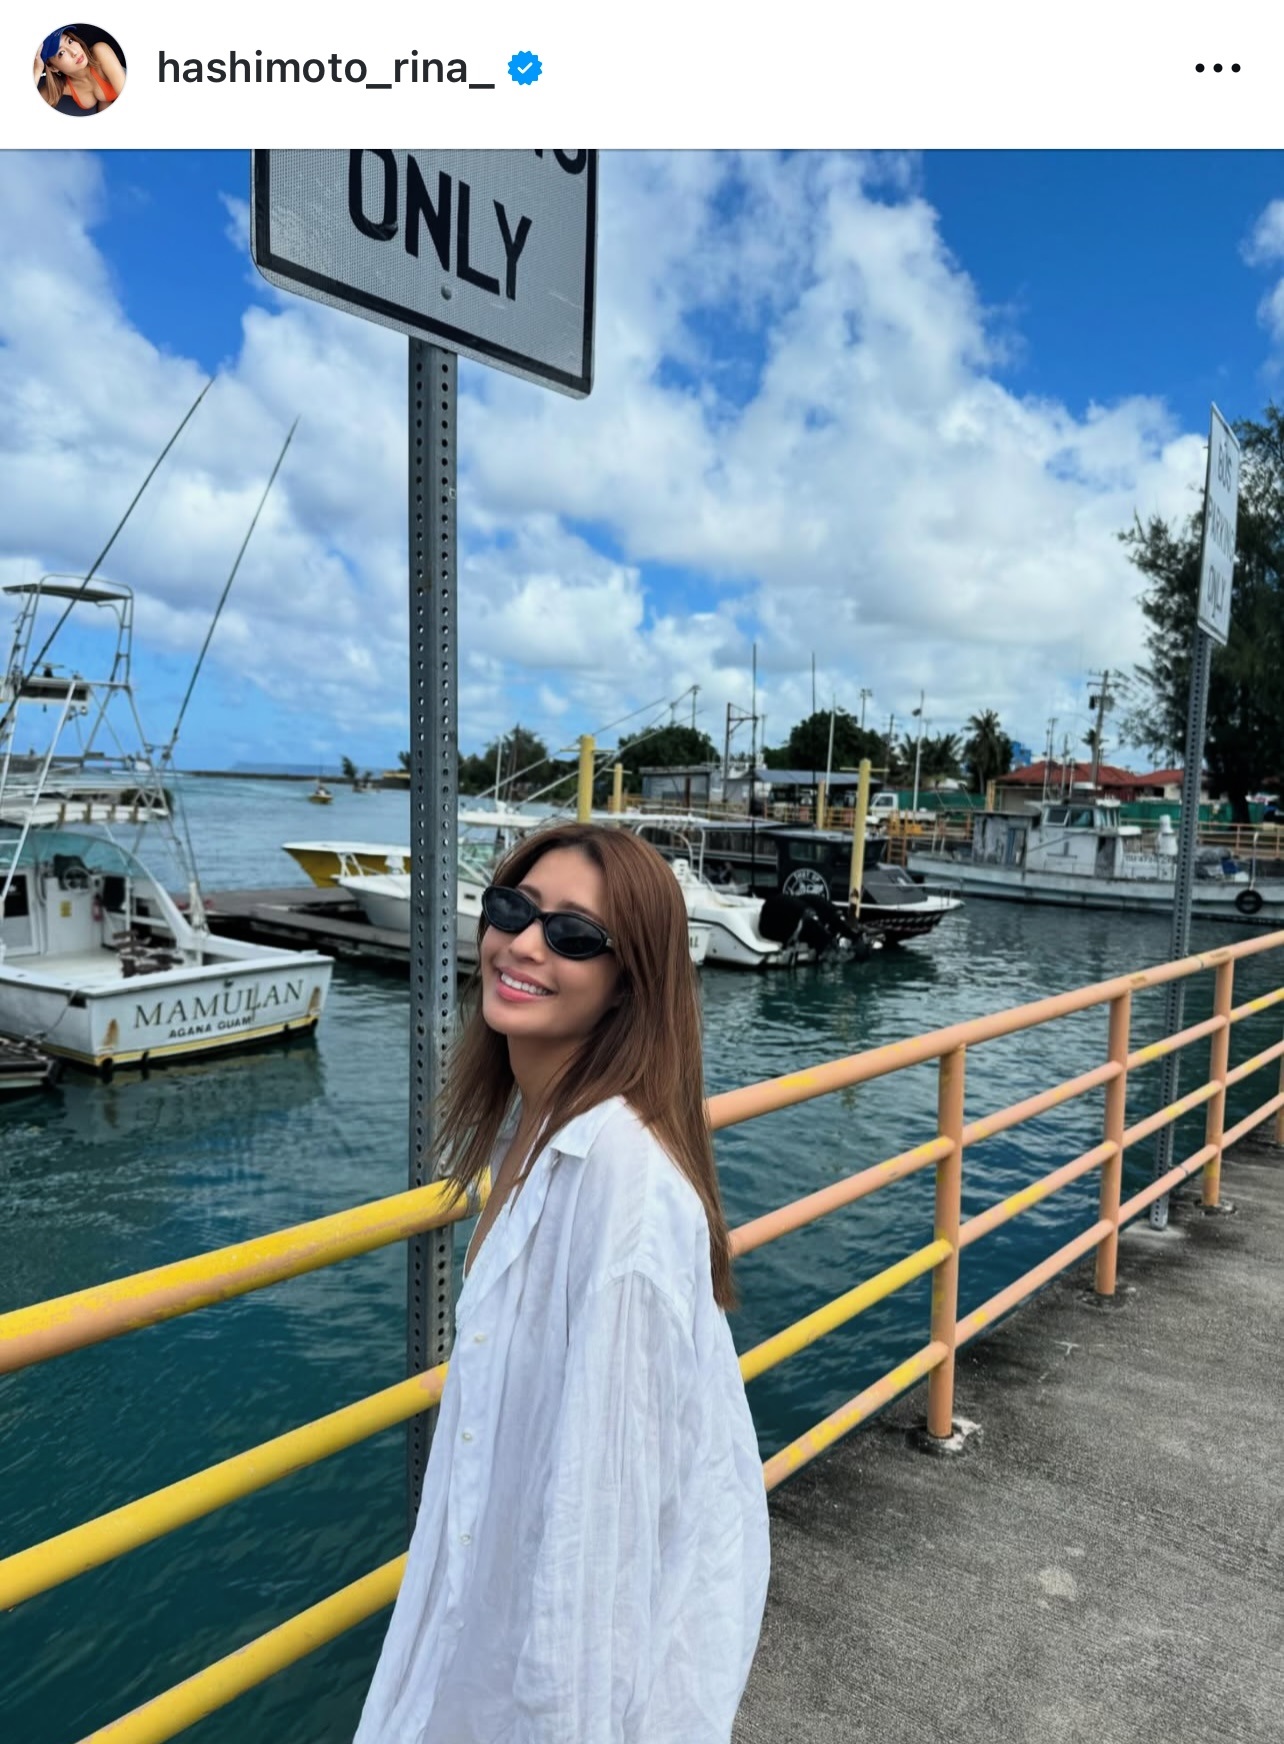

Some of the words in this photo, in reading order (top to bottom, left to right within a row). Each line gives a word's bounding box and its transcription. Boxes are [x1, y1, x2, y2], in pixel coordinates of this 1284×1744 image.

[348, 150, 533, 301] ONLY
[134, 979, 304, 1028] MAMULAN
[169, 1023, 212, 1039] AGANA
[217, 1016, 252, 1030] GUAM
